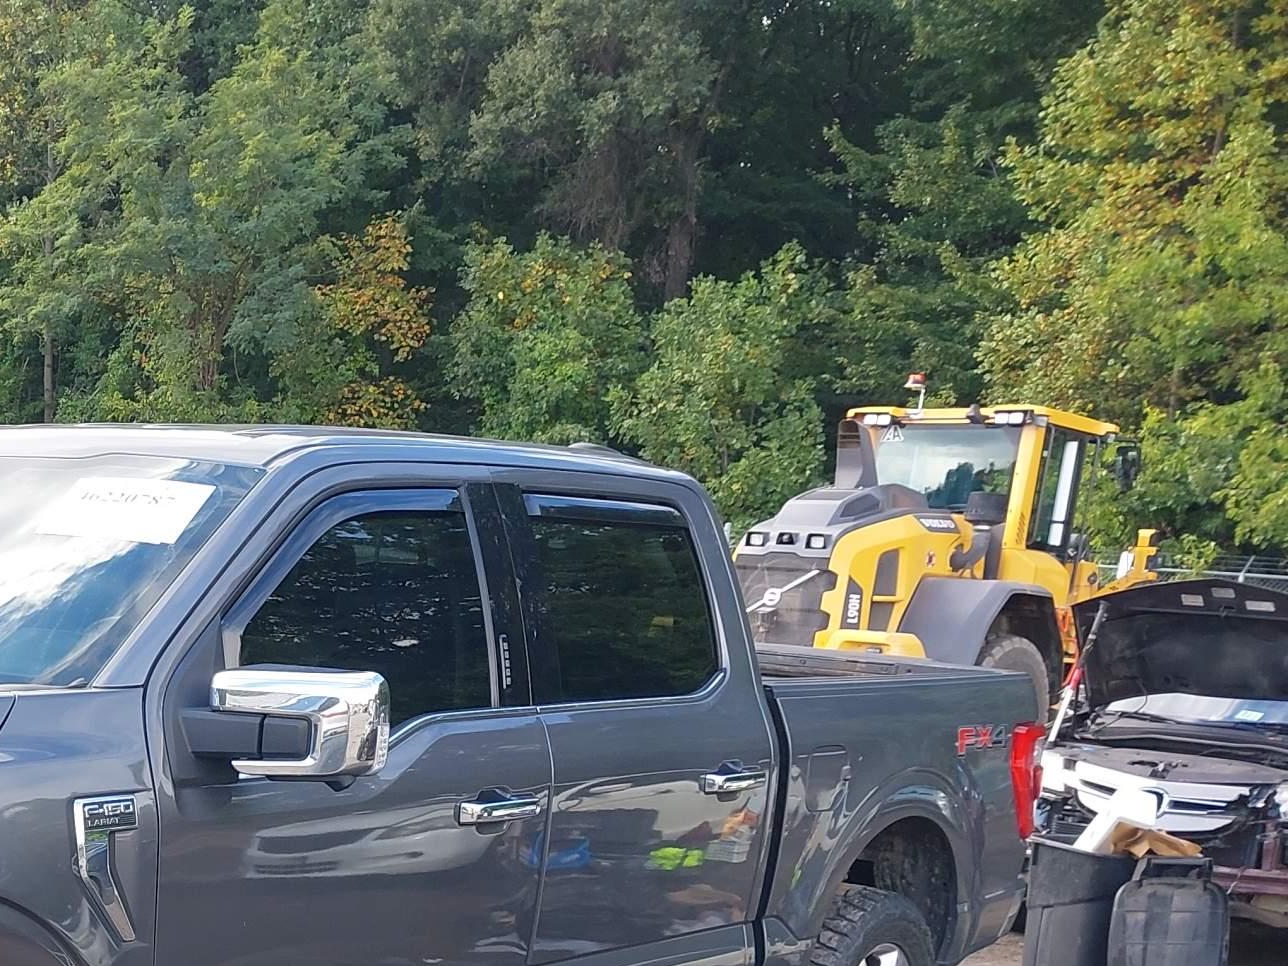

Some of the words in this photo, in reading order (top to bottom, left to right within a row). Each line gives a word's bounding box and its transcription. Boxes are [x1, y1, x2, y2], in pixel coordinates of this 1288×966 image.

[846, 593, 861, 625] L90H
[957, 726, 1008, 754] FX4
[84, 801, 133, 818] F-150
[88, 816, 120, 827] LARIAT
